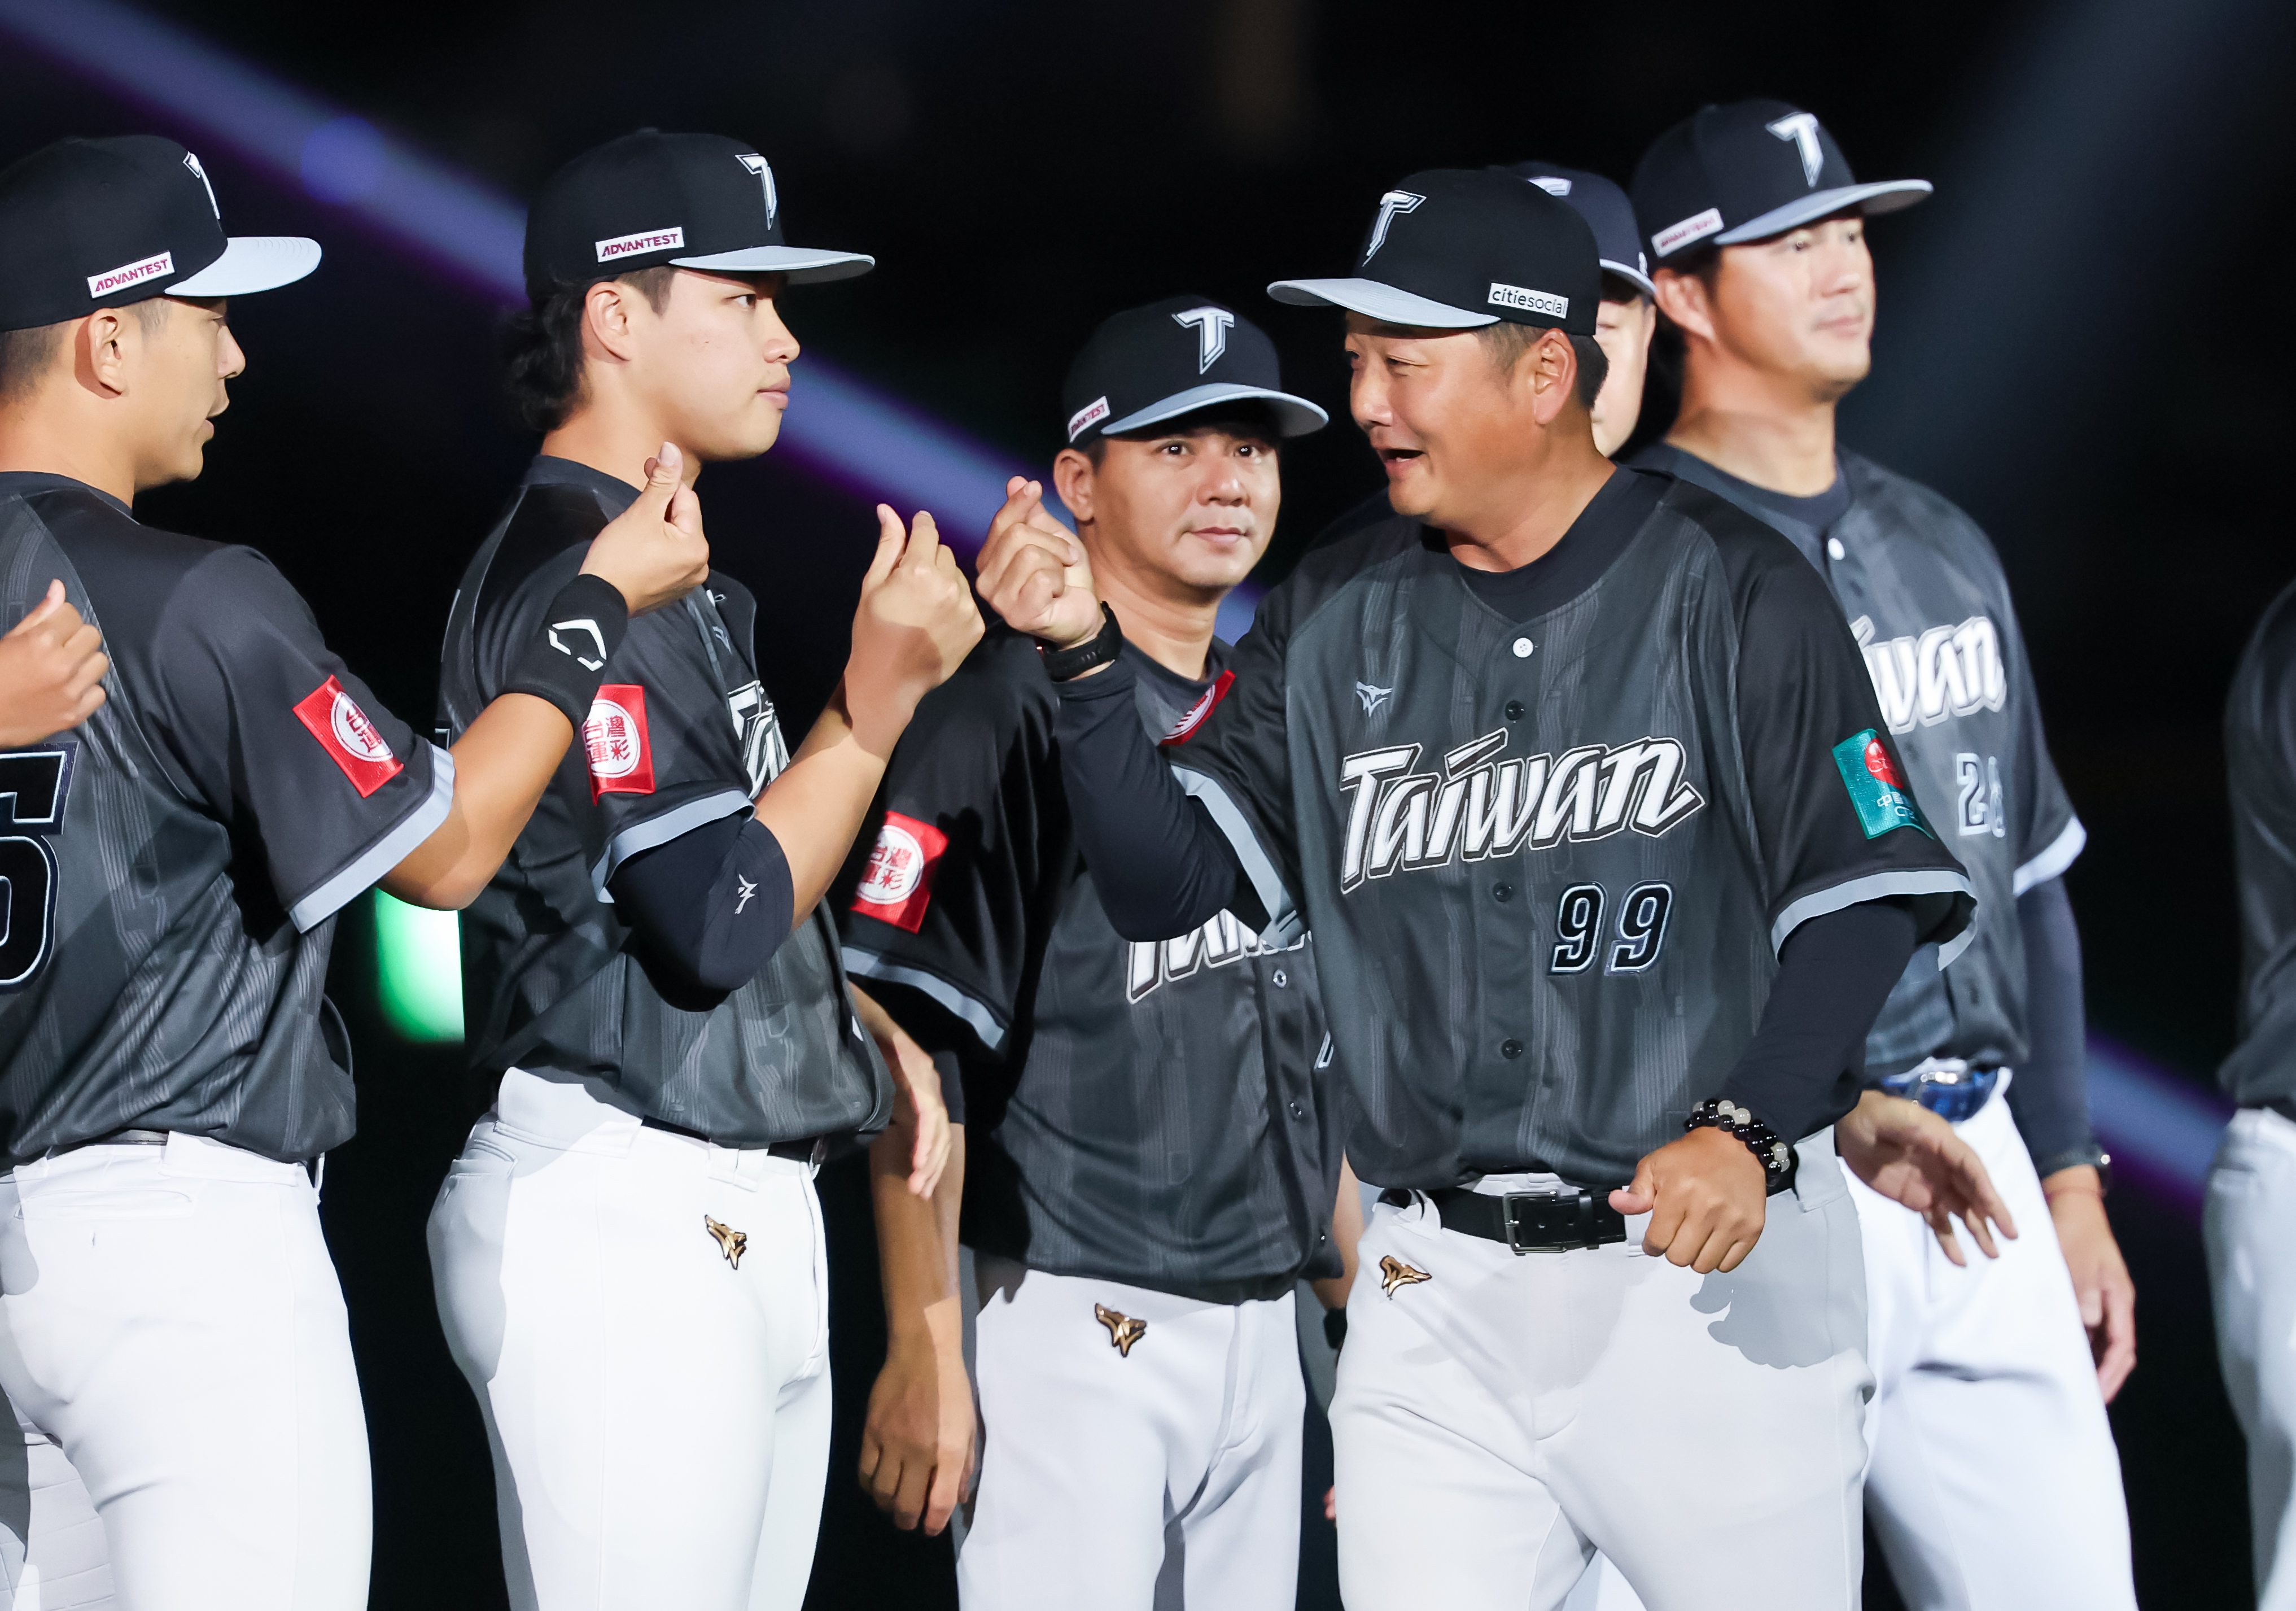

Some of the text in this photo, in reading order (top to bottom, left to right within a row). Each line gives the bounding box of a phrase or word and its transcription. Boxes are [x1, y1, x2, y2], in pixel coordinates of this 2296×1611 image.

[602, 233, 678, 257] ADVANTEST
[95, 259, 168, 292] ADVANTEST
[1492, 287, 1567, 315] citiesocial
[1171, 306, 1235, 374] T
[1340, 727, 1706, 894] Taiwan
[1548, 880, 1674, 976] 99
